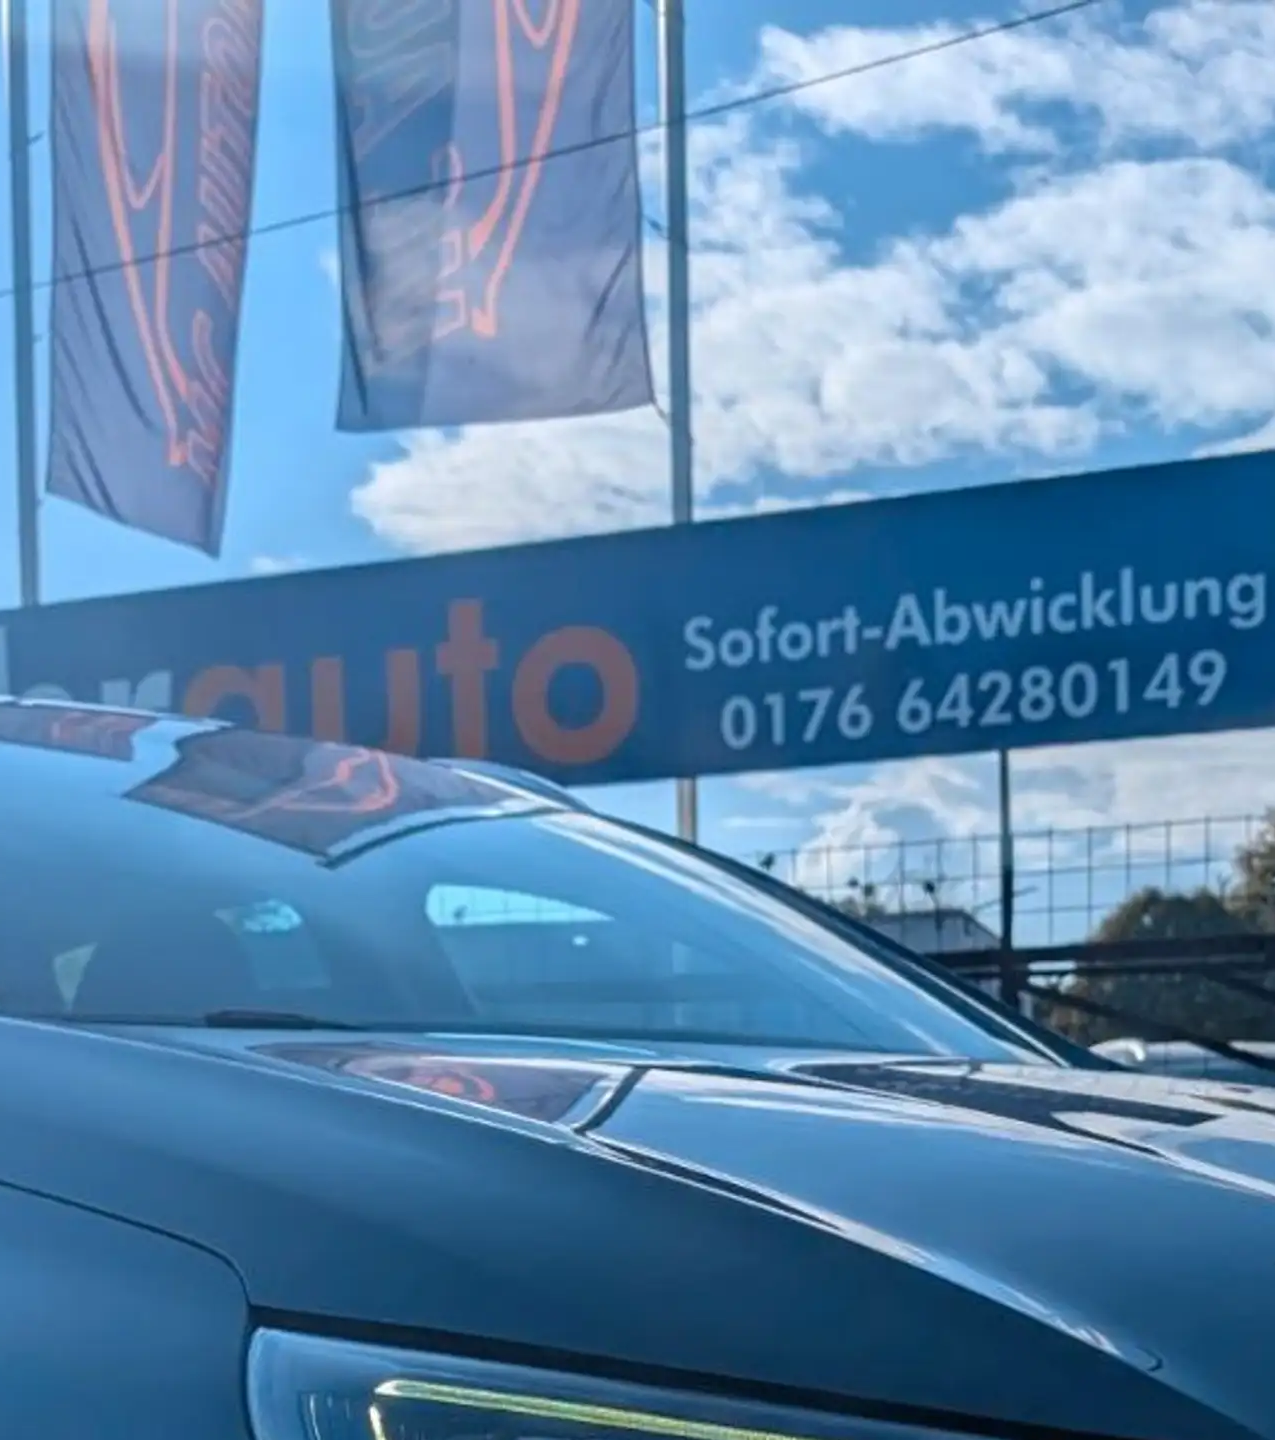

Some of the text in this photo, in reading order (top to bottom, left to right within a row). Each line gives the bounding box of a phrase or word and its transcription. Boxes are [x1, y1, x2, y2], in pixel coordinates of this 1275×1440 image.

[684, 567, 1267, 671] Sofort-Abwicklung
[720, 649, 1227, 750] 0176 64280149
